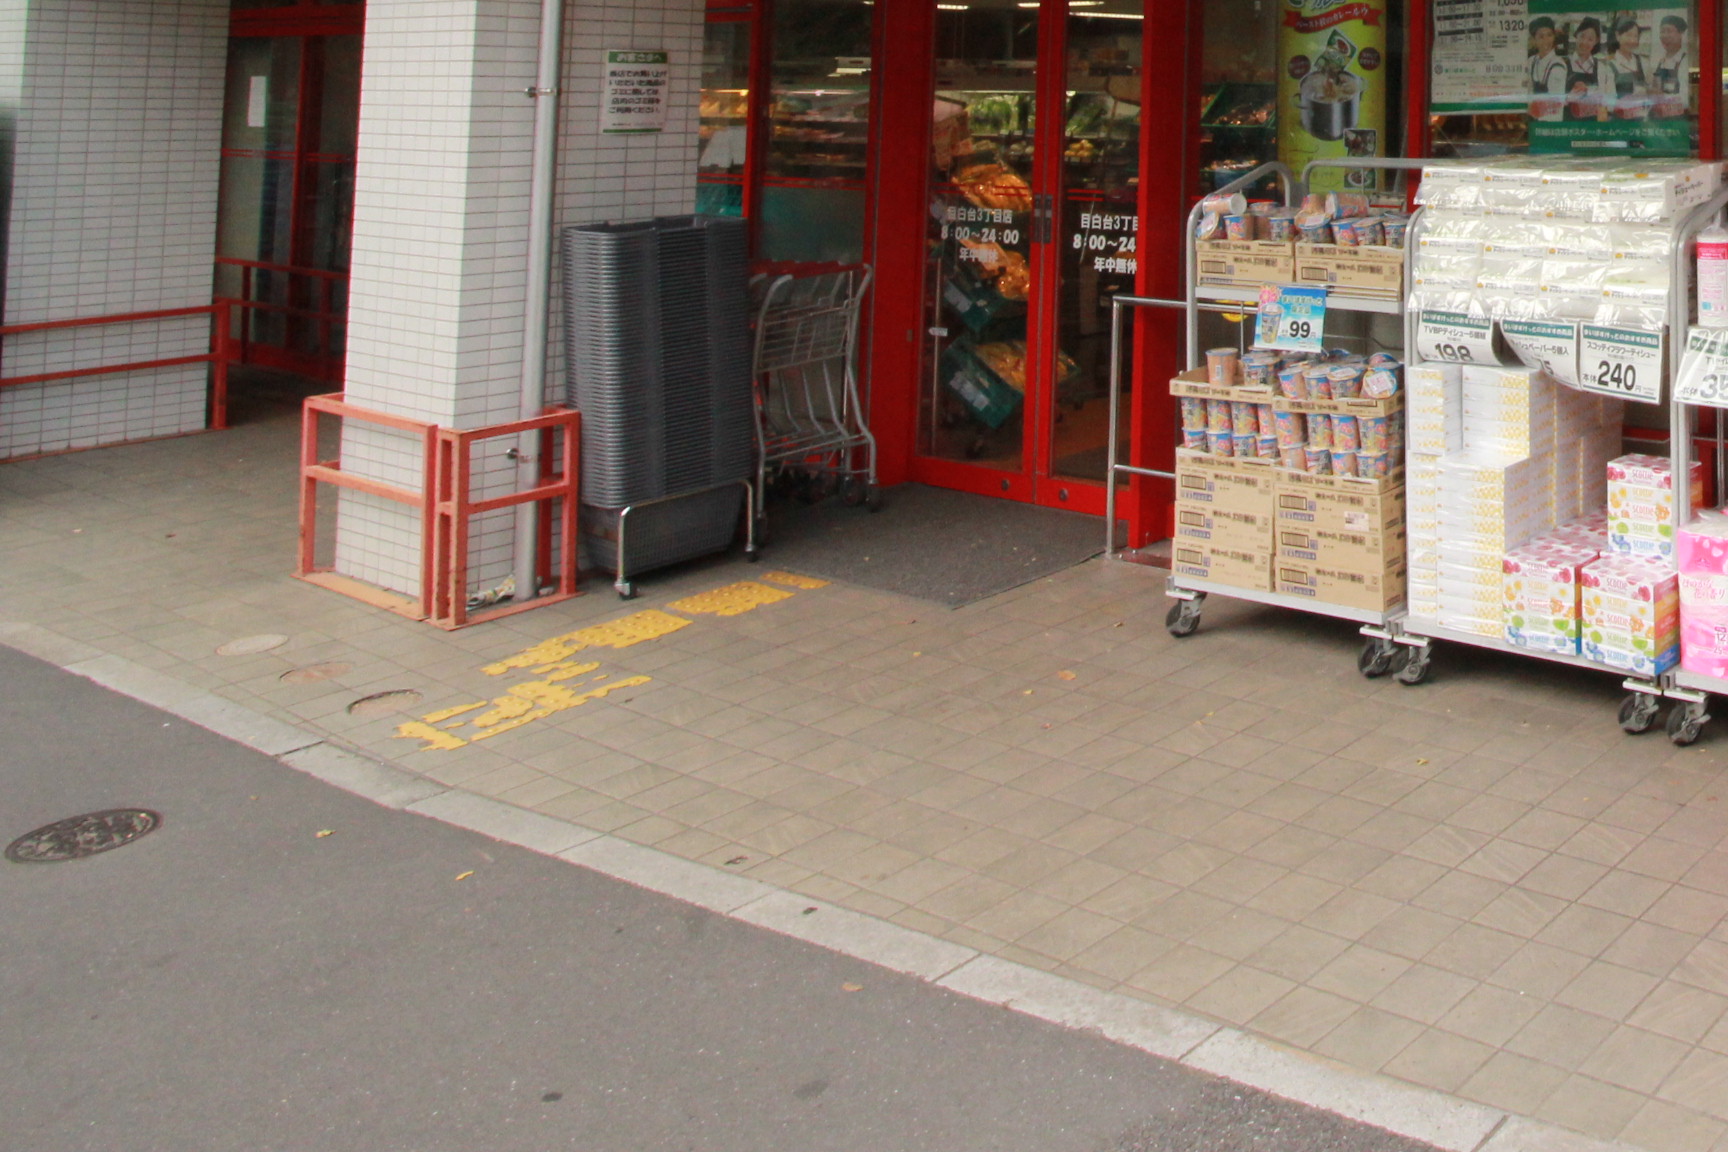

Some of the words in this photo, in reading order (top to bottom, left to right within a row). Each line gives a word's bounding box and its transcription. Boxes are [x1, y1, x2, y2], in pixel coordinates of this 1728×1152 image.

[947, 207, 1013, 224] 目白台3丁目店
[1080, 213, 1137, 231] 目白台3丁目
[1094, 256, 1137, 275] 年中無休
[1289, 320, 1311, 339] 99
[1435, 342, 1474, 362] 198
[1598, 360, 1636, 391] 240
[1694, 587, 1726, 600] 花の香り
[1716, 632, 1727, 642] 12
